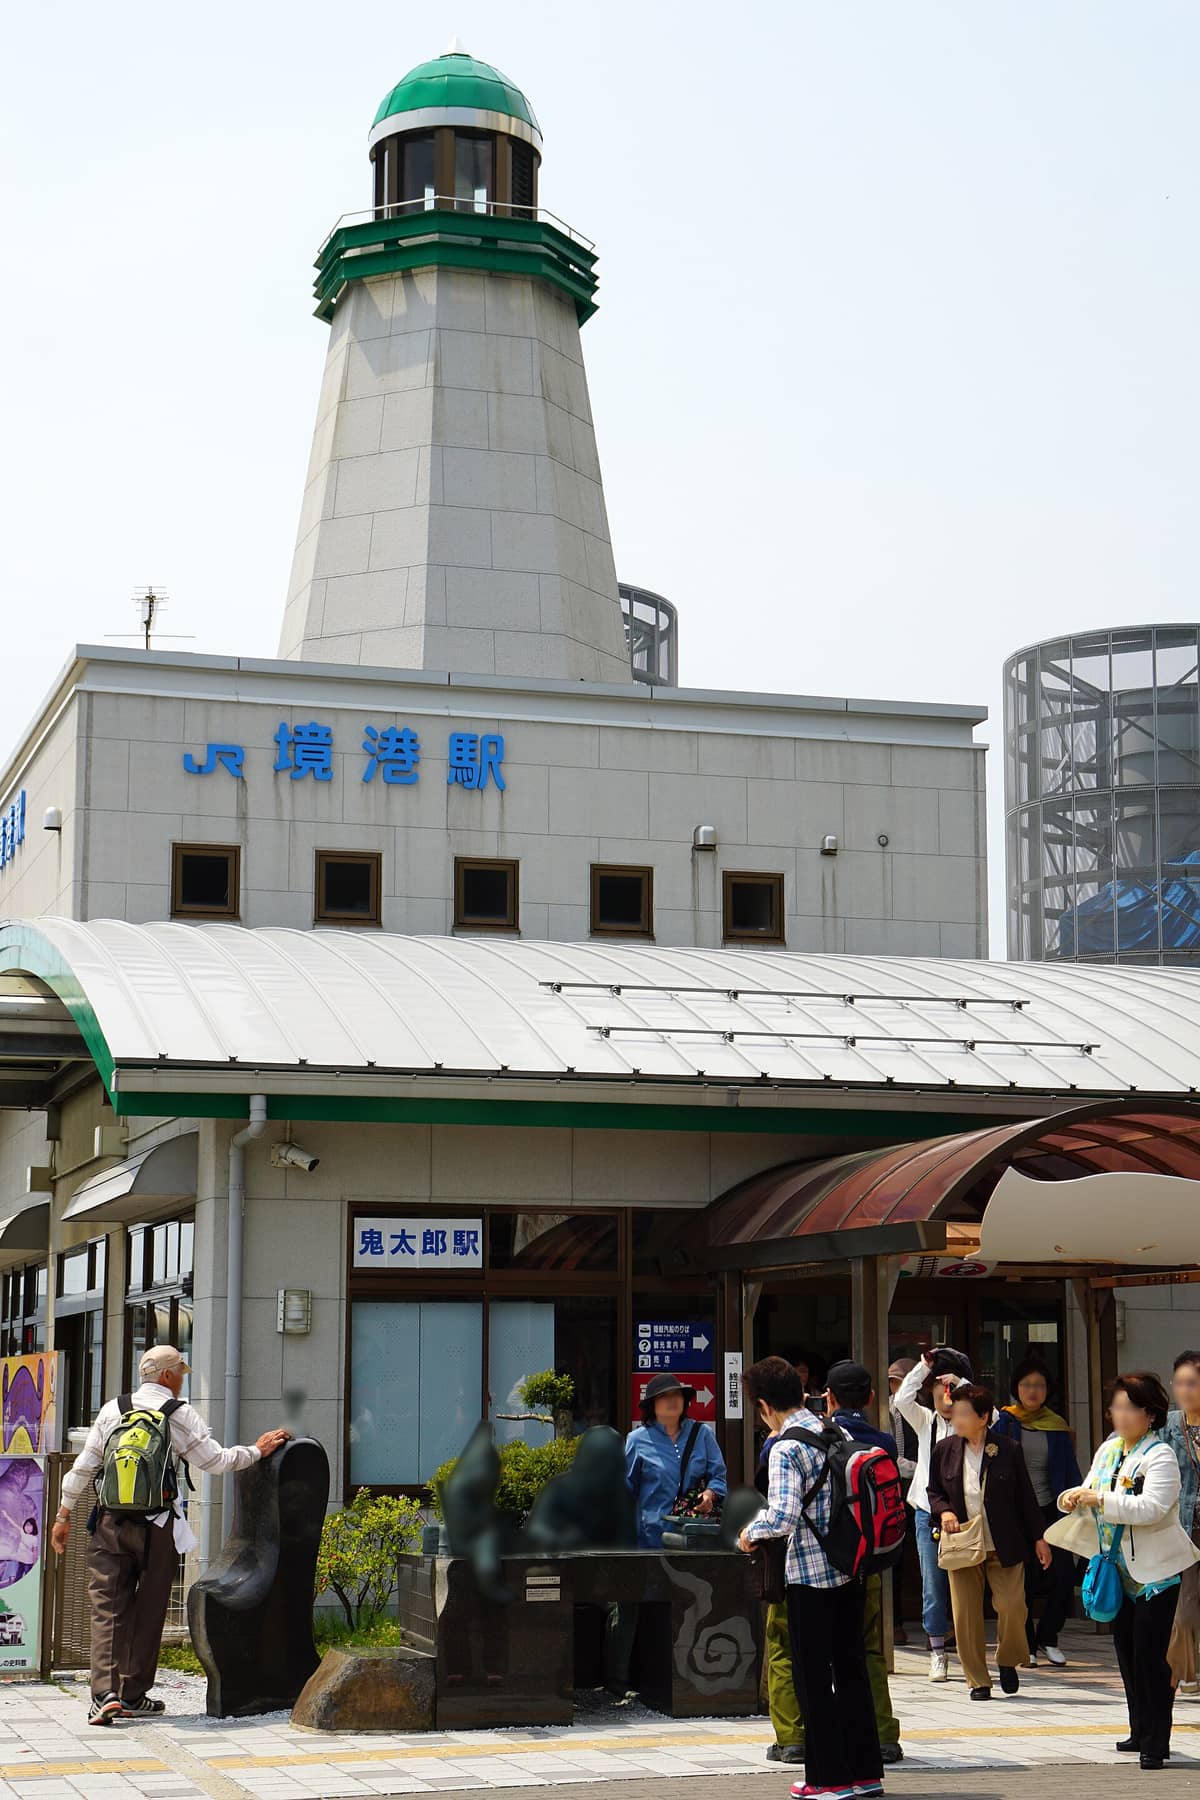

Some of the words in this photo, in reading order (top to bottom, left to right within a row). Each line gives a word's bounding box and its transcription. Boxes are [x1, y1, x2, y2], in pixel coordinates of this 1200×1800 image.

[358, 1228, 480, 1256] 鬼太郎駅
[728, 1372, 739, 1409] 終日禁煙
